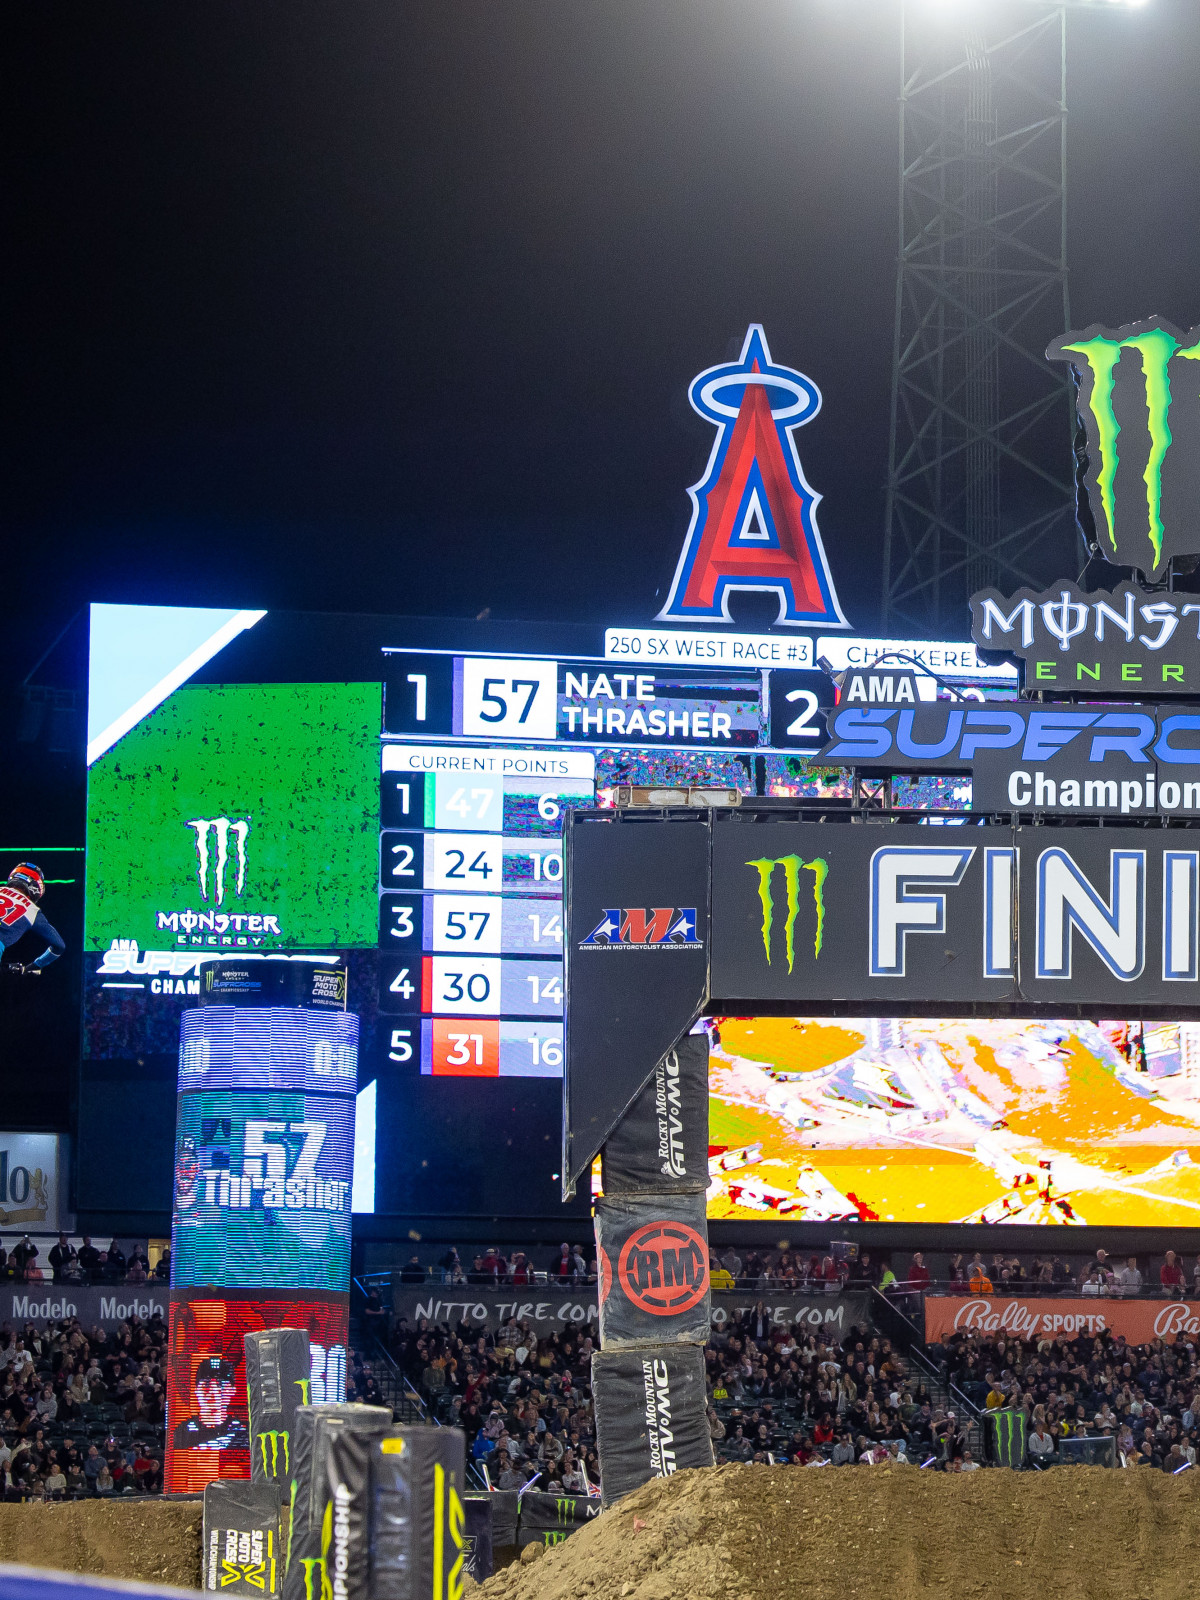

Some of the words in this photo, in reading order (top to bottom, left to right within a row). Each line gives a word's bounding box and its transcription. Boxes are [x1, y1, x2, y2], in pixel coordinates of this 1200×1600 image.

[610, 636, 641, 655] 250
[647, 639, 668, 656] SX
[675, 640, 730, 659] WEST
[734, 643, 783, 660] RACE
[787, 644, 807, 661] #3
[406, 674, 427, 721] 1
[479, 679, 540, 724] 57
[564, 673, 656, 702] NATE
[847, 676, 915, 702] AMA
[563, 707, 732, 739] THRASHER
[786, 690, 820, 736] 2
[409, 755, 496, 771] CURRENT
[503, 759, 569, 773] POINTS
[396, 783, 410, 814] 1
[446, 787, 495, 819] 47
[537, 793, 560, 820] 6
[391, 845, 415, 876] 2
[445, 850, 493, 879] 24
[529, 853, 563, 881] 10
[177, 935, 262, 945] ENERGY
[391, 907, 413, 937] 3
[446, 912, 490, 940] 57
[528, 915, 563, 942] 14
[578, 908, 704, 944] AMA
[312, 989, 338, 998] CROSS
[315, 982, 338, 991] MOTO
[389, 969, 415, 999] 4
[443, 973, 490, 1002] 30
[527, 976, 563, 1004] 14
[389, 1030, 413, 1061] 5
[446, 1034, 483, 1065] 31
[528, 1037, 563, 1066] 16
[244, 1121, 327, 1180] 57
[659, 1118, 669, 1159] ROCKY
[12, 1296, 77, 1319] Modelo
[101, 1296, 165, 1319] Modelo
[414, 1297, 488, 1320] NITTO
[954, 1300, 1041, 1341] Bally
[1042, 1314, 1106, 1333] SPORTS
[642, 1360, 657, 1427] MOUNTAIN
[651, 1429, 662, 1469] ROCKY
[225, 1529, 238, 1564] CROSS
[238, 1531, 251, 1563] MOTO
[251, 1529, 264, 1565] SUPER
[333, 1483, 350, 1600] PIONSHIP
